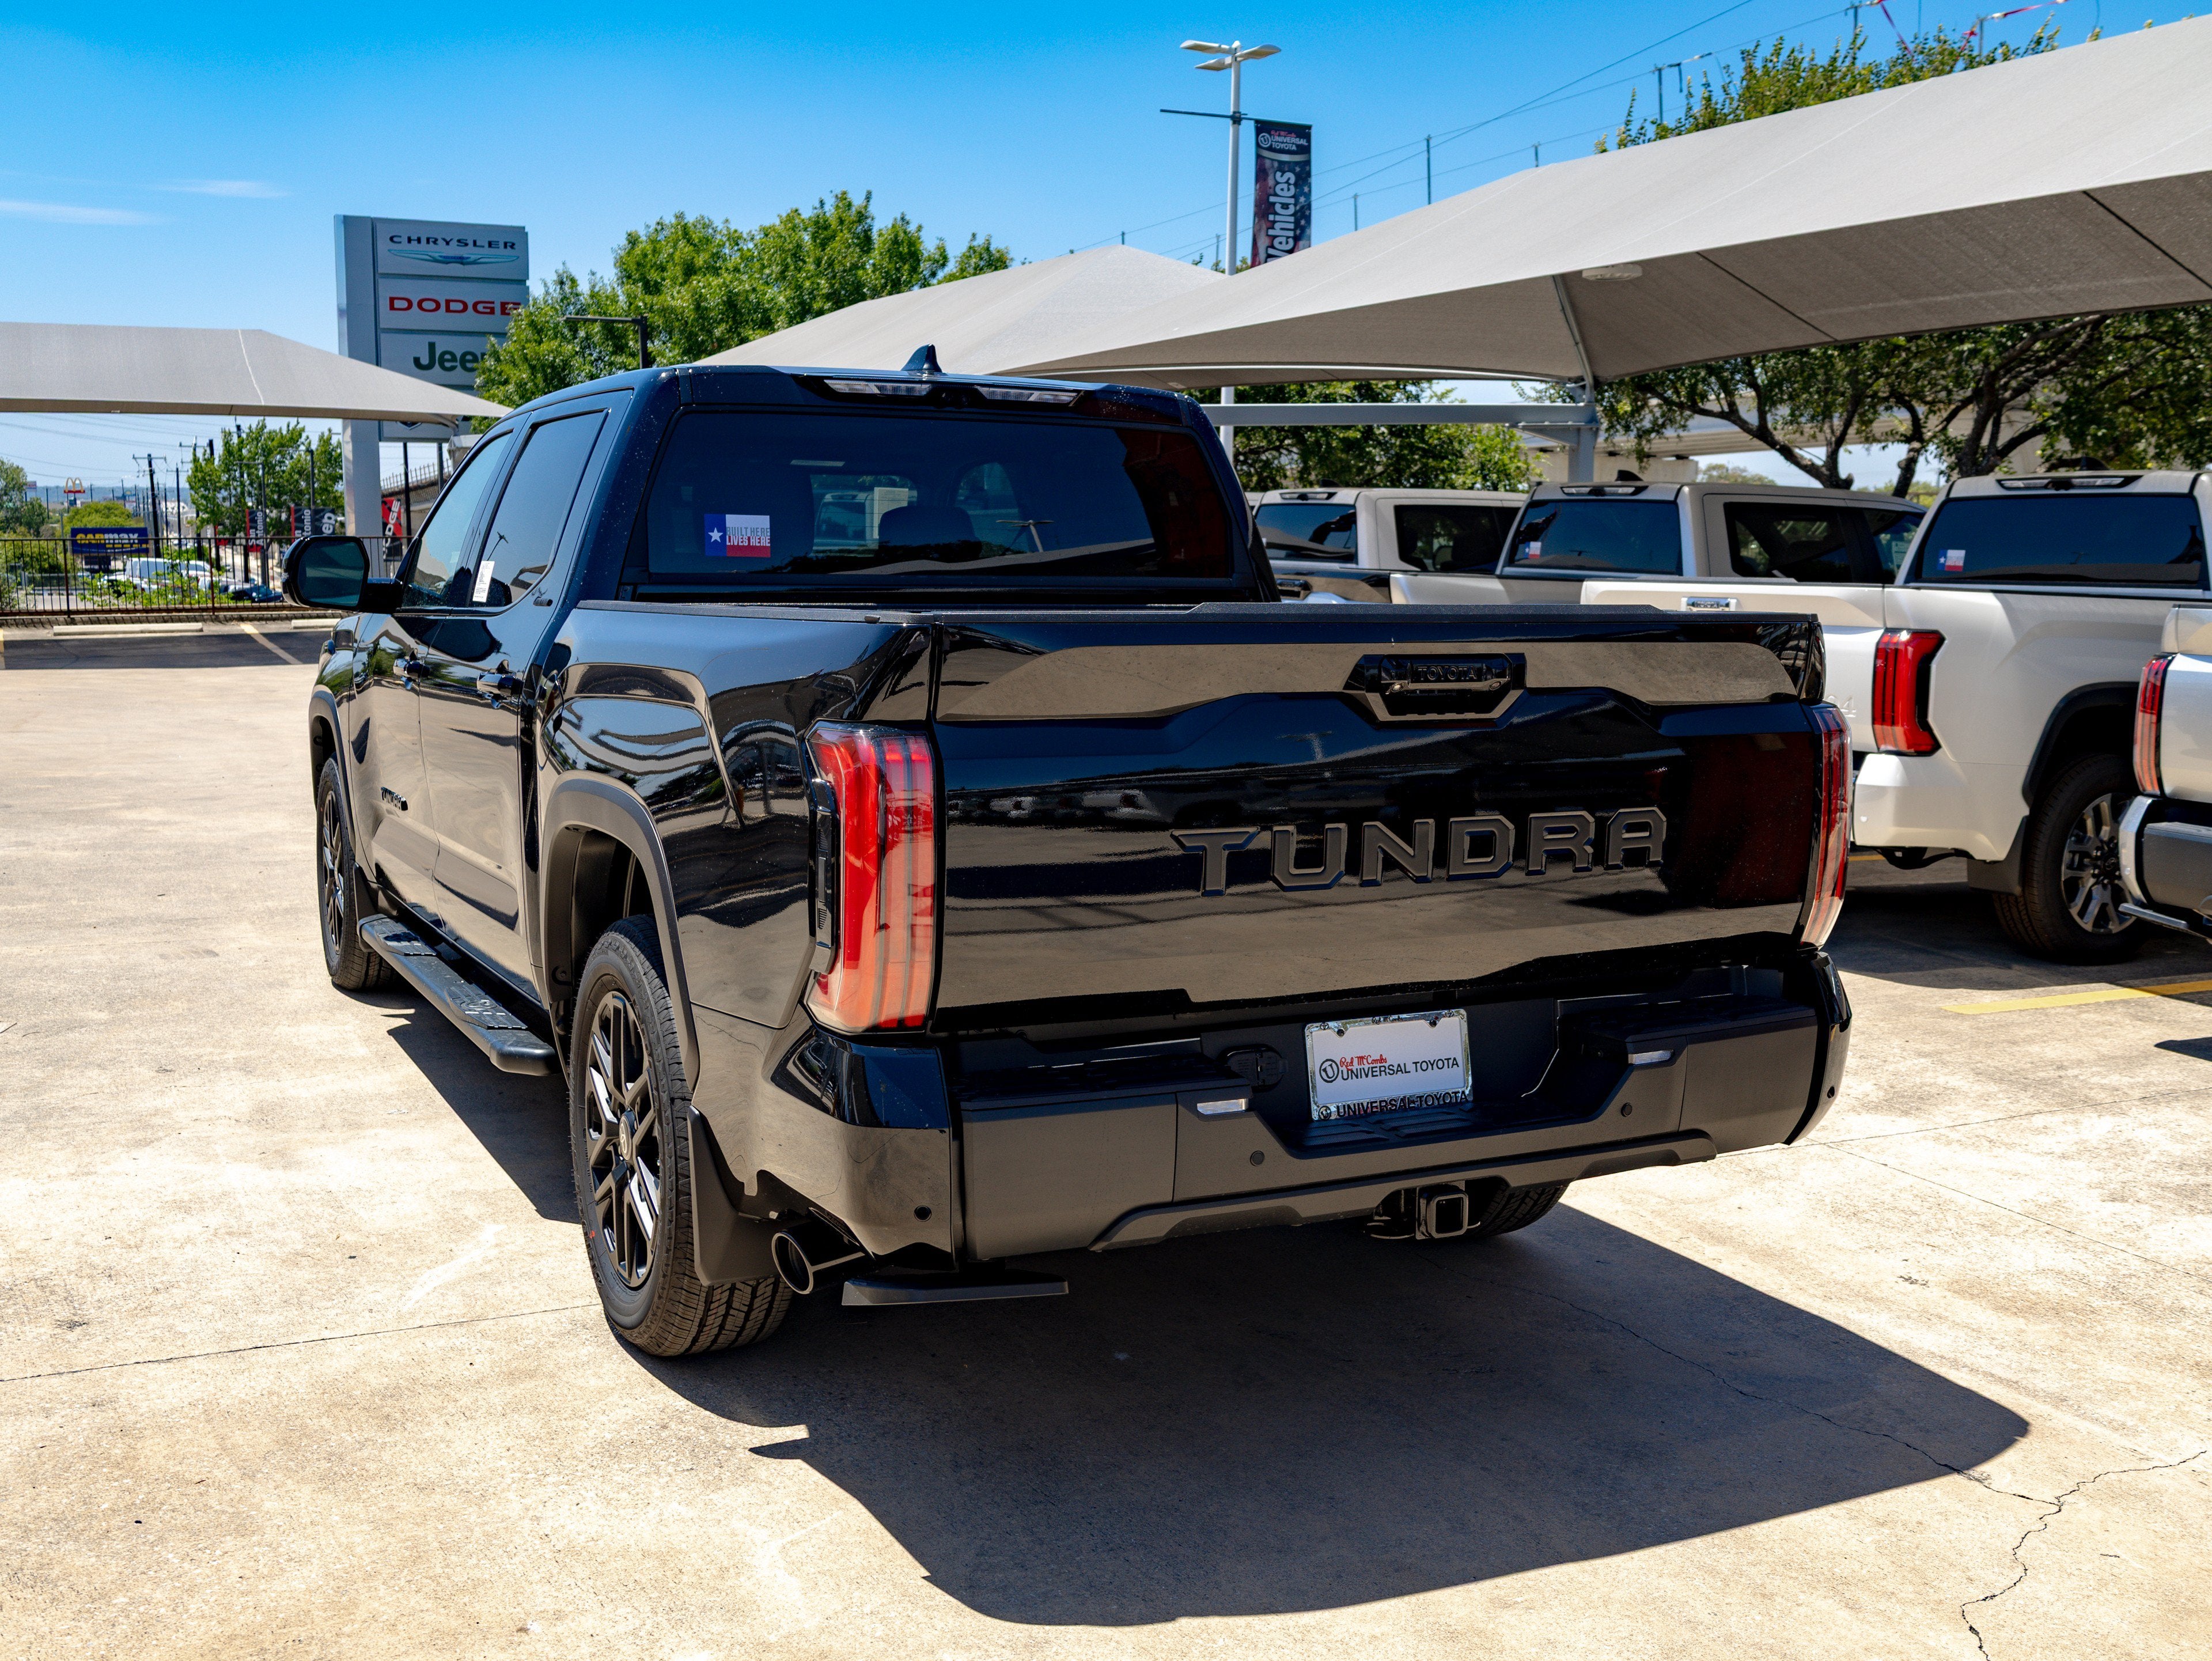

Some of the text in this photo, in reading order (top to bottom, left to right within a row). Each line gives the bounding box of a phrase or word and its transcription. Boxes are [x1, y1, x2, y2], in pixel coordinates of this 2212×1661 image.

[1271, 135, 1308, 145] UNIVERSAL
[1267, 171, 1296, 262] Vehicles
[389, 234, 516, 250] CHRYSLER
[389, 297, 521, 316] DODGE
[413, 342, 485, 372] Jee
[302, 509, 311, 536] tonio
[382, 500, 400, 559] ODGE
[726, 527, 770, 536] BUILT HERE
[726, 536, 770, 546] LIVES HERE
[1417, 665, 1476, 680] TOYOTA
[1170, 807, 1666, 897] TUNDRA
[1339, 1054, 1387, 1071] Red McCombs
[1341, 1057, 1459, 1081] UNIVERSAL TOYOTA
[1336, 1091, 1468, 1118] UNIVERSAL TOYOTA
